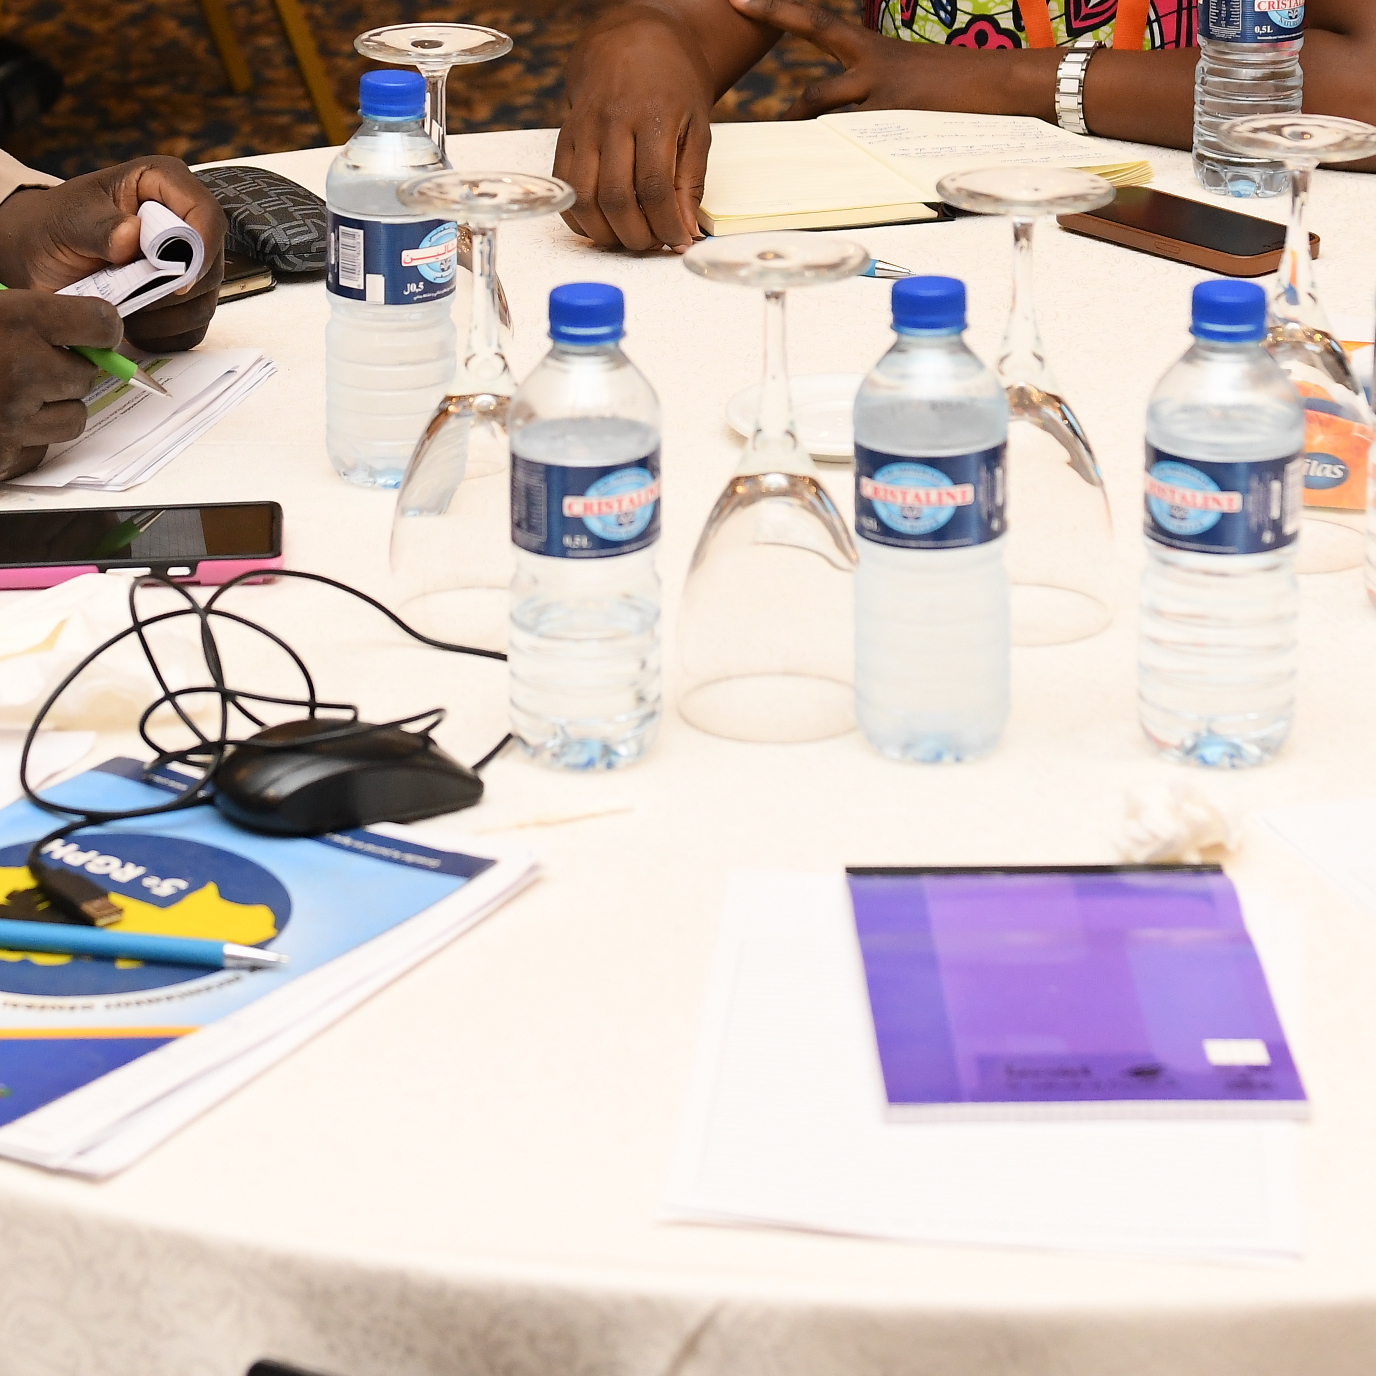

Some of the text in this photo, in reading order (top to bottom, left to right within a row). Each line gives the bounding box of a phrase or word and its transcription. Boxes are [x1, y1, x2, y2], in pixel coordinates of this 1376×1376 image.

[1303, 458, 1346, 479] ilas
[1145, 478, 1236, 511] RISTALINE
[39, 837, 148, 884] RGPH
